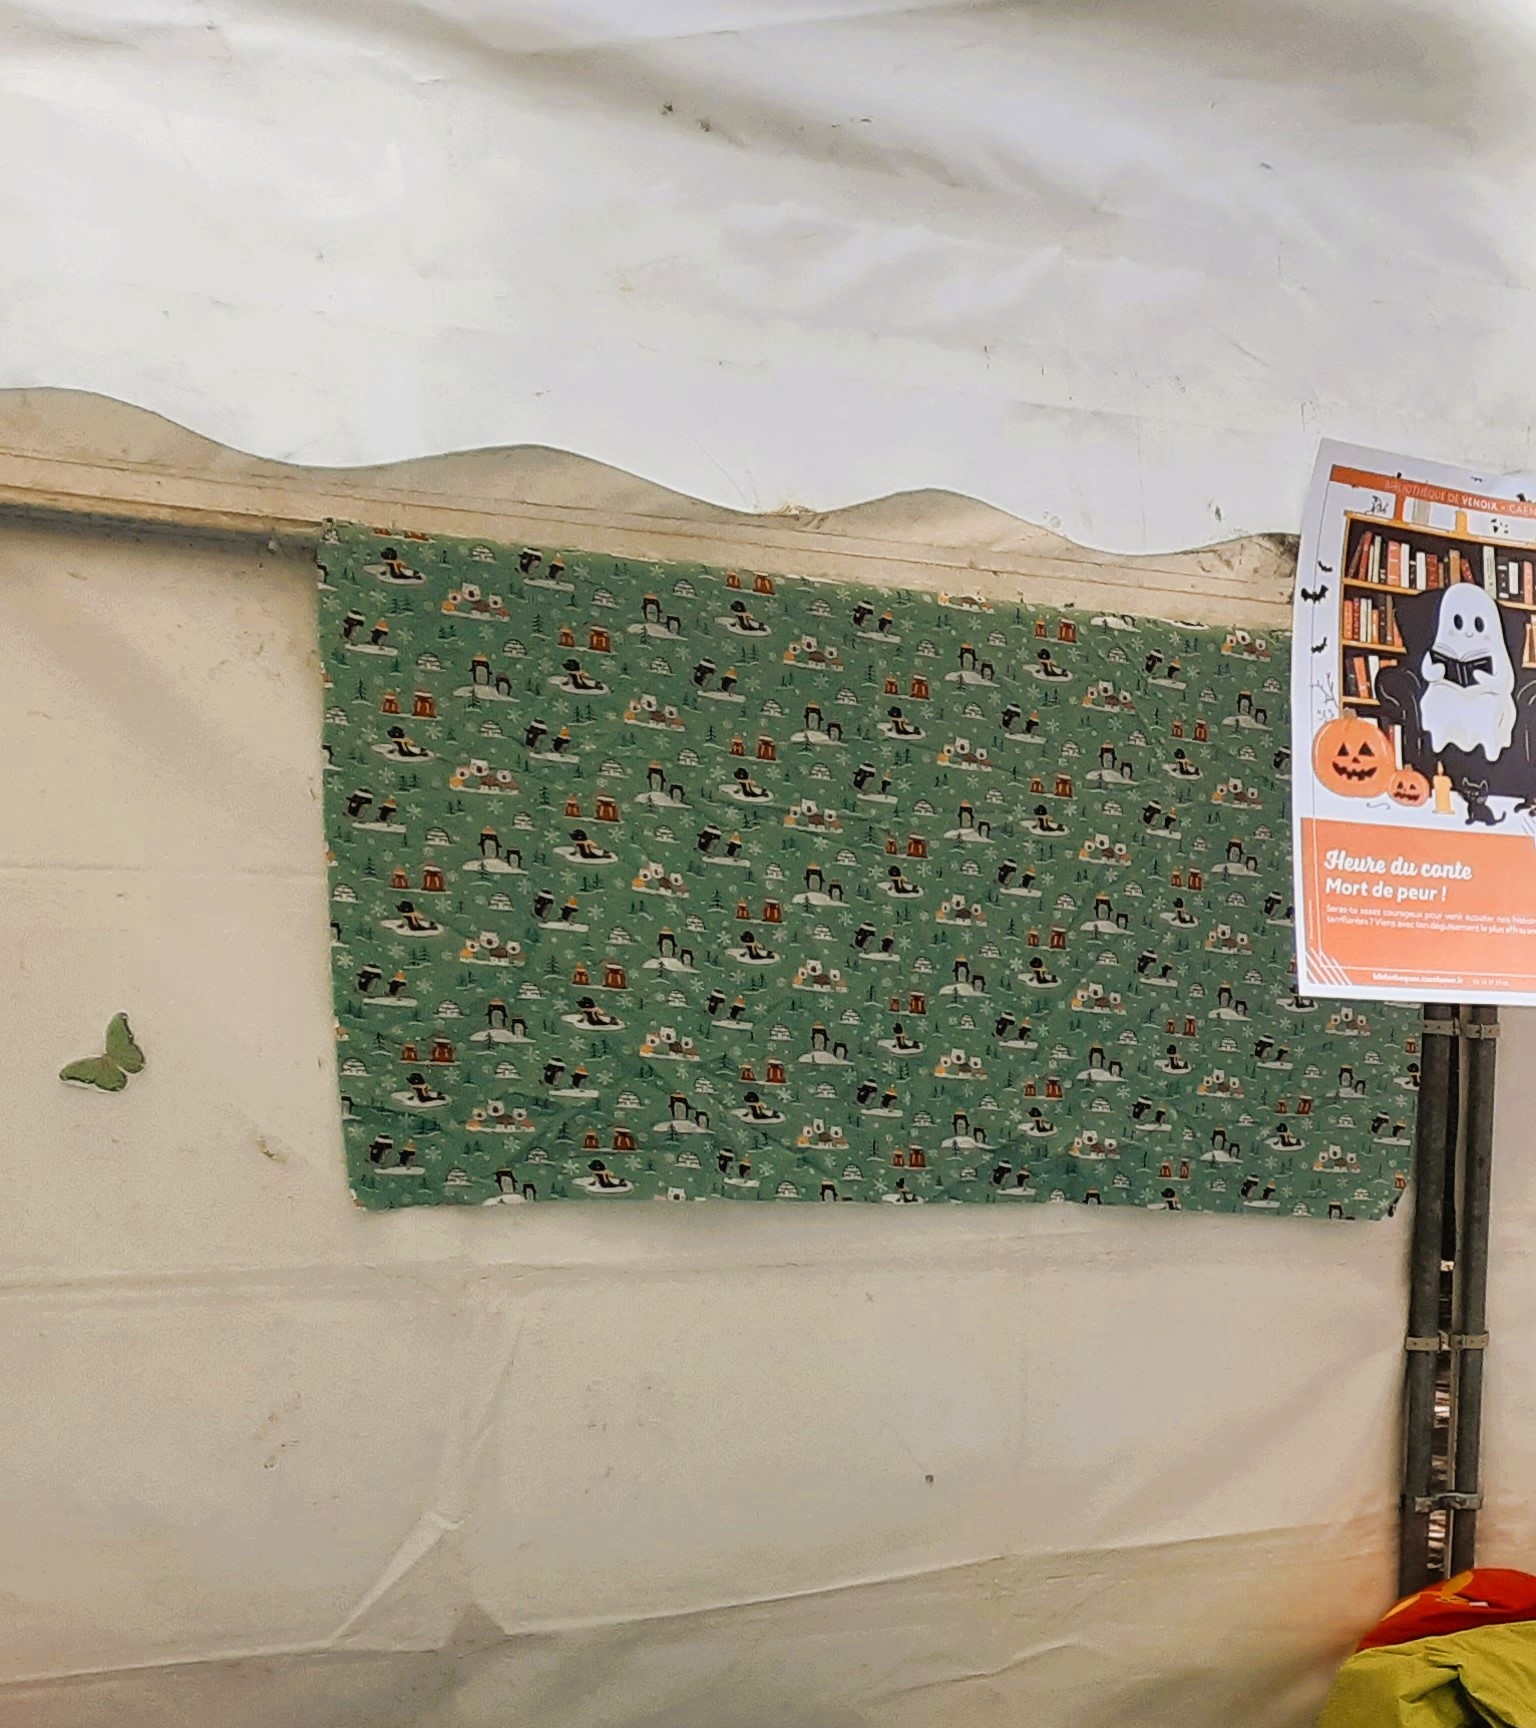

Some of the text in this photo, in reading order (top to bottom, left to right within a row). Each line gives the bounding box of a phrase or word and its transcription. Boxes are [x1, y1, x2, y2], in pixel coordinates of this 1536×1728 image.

[1461, 495, 1498, 511] VENOIX
[1508, 506, 1536, 517] CAEN
[1324, 849, 1472, 880] Heure du conte
[1325, 877, 1368, 897] Mort
[1372, 881, 1393, 898] de
[1396, 886, 1438, 903] peur
